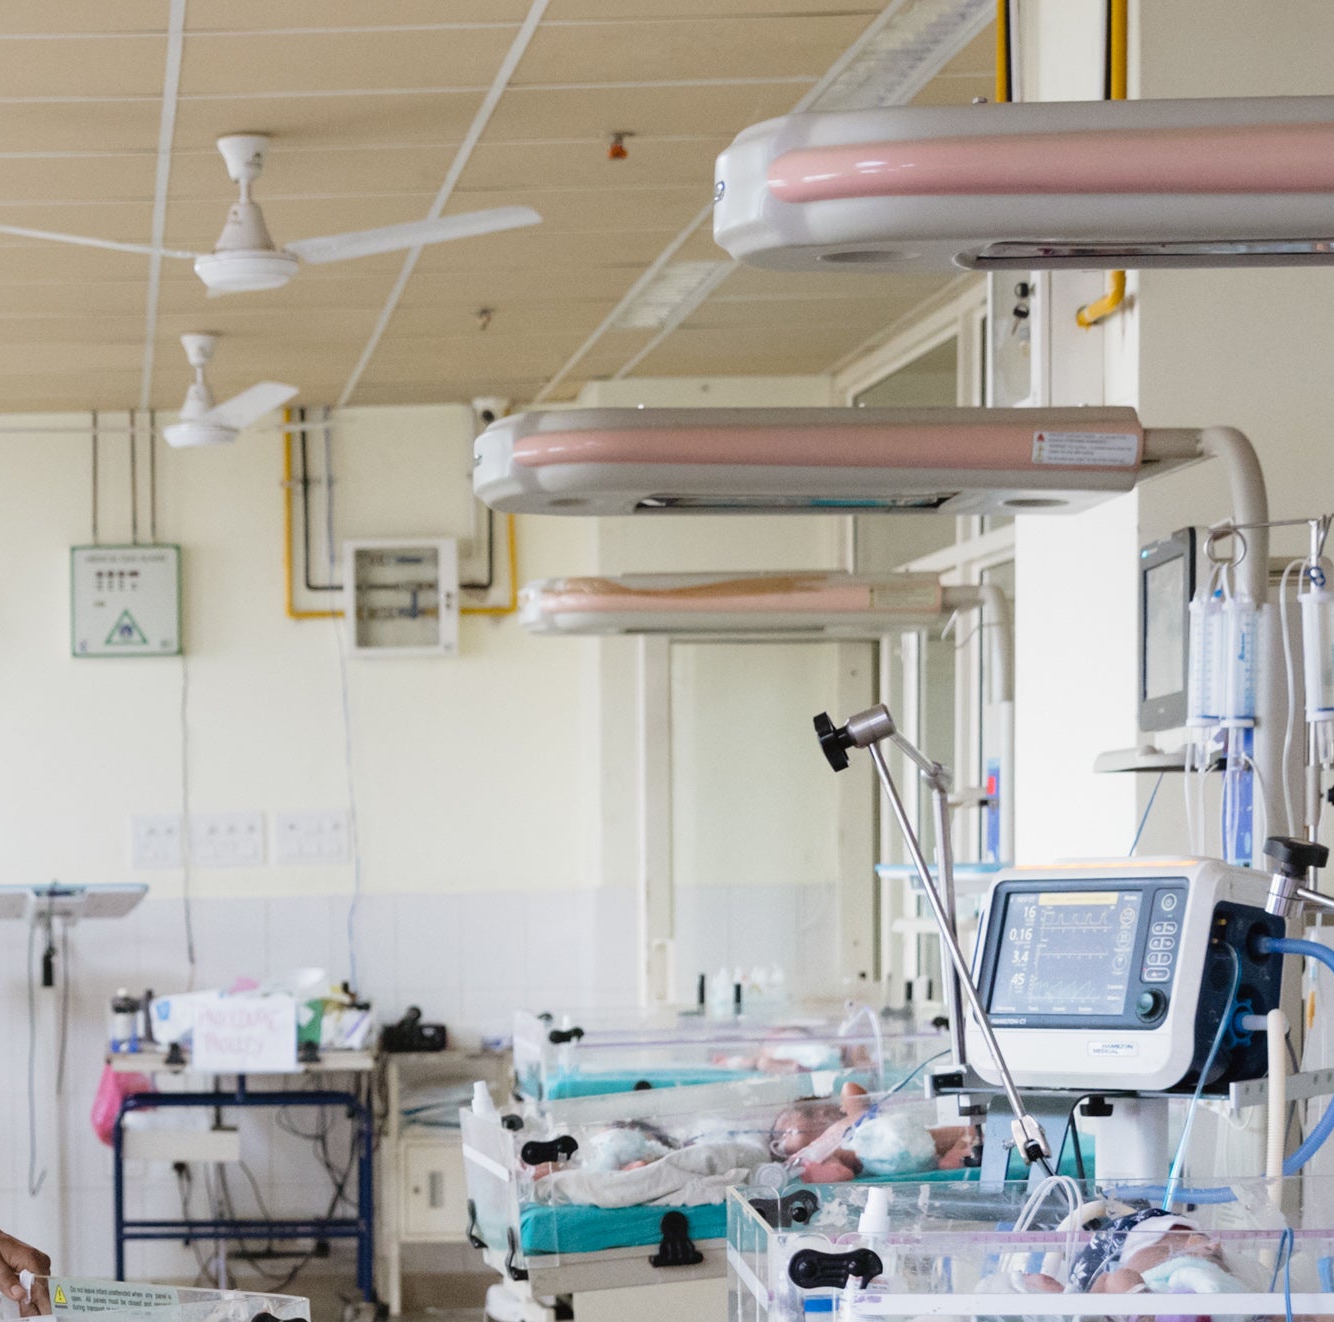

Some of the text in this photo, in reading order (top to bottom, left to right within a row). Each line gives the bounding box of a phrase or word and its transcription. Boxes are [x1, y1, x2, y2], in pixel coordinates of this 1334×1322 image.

[1024, 906, 1036, 918] 16
[1009, 928, 1033, 941] 0.16
[1012, 951, 1028, 963] 3.4
[1011, 973, 1025, 985] 45
